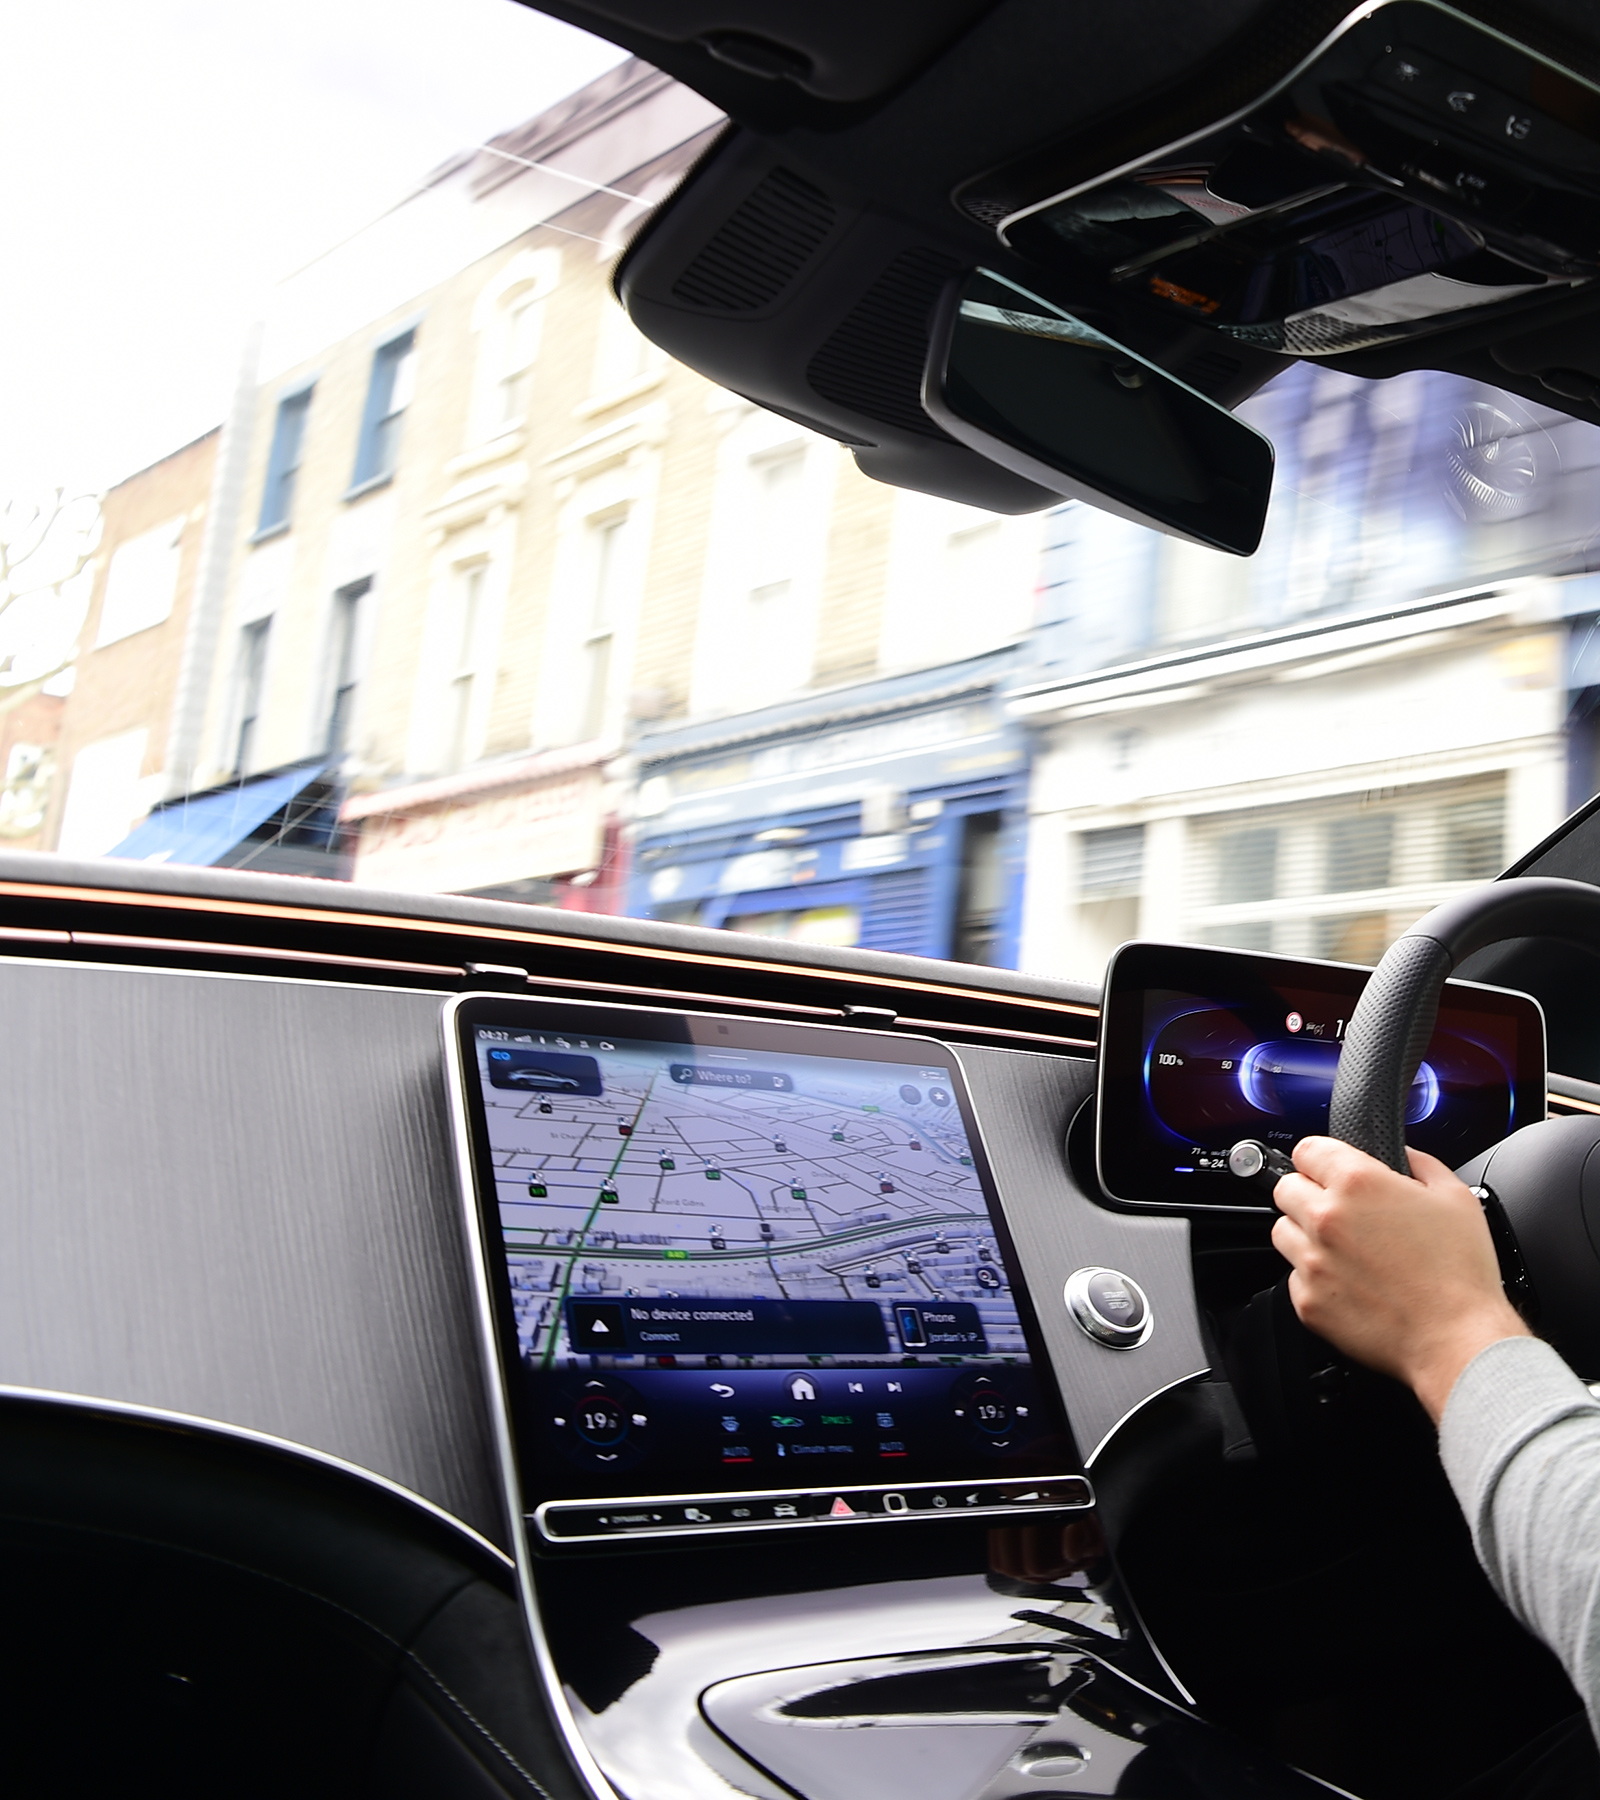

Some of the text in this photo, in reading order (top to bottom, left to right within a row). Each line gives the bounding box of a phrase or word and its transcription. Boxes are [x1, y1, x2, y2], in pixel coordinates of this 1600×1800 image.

[697, 1069, 752, 1084] Where to?
[630, 1307, 755, 1322] No device connected
[922, 1311, 957, 1323] Phone
[639, 1330, 681, 1342] Connect
[722, 1445, 752, 1457] AUTO
[879, 1441, 906, 1452] AUTO
